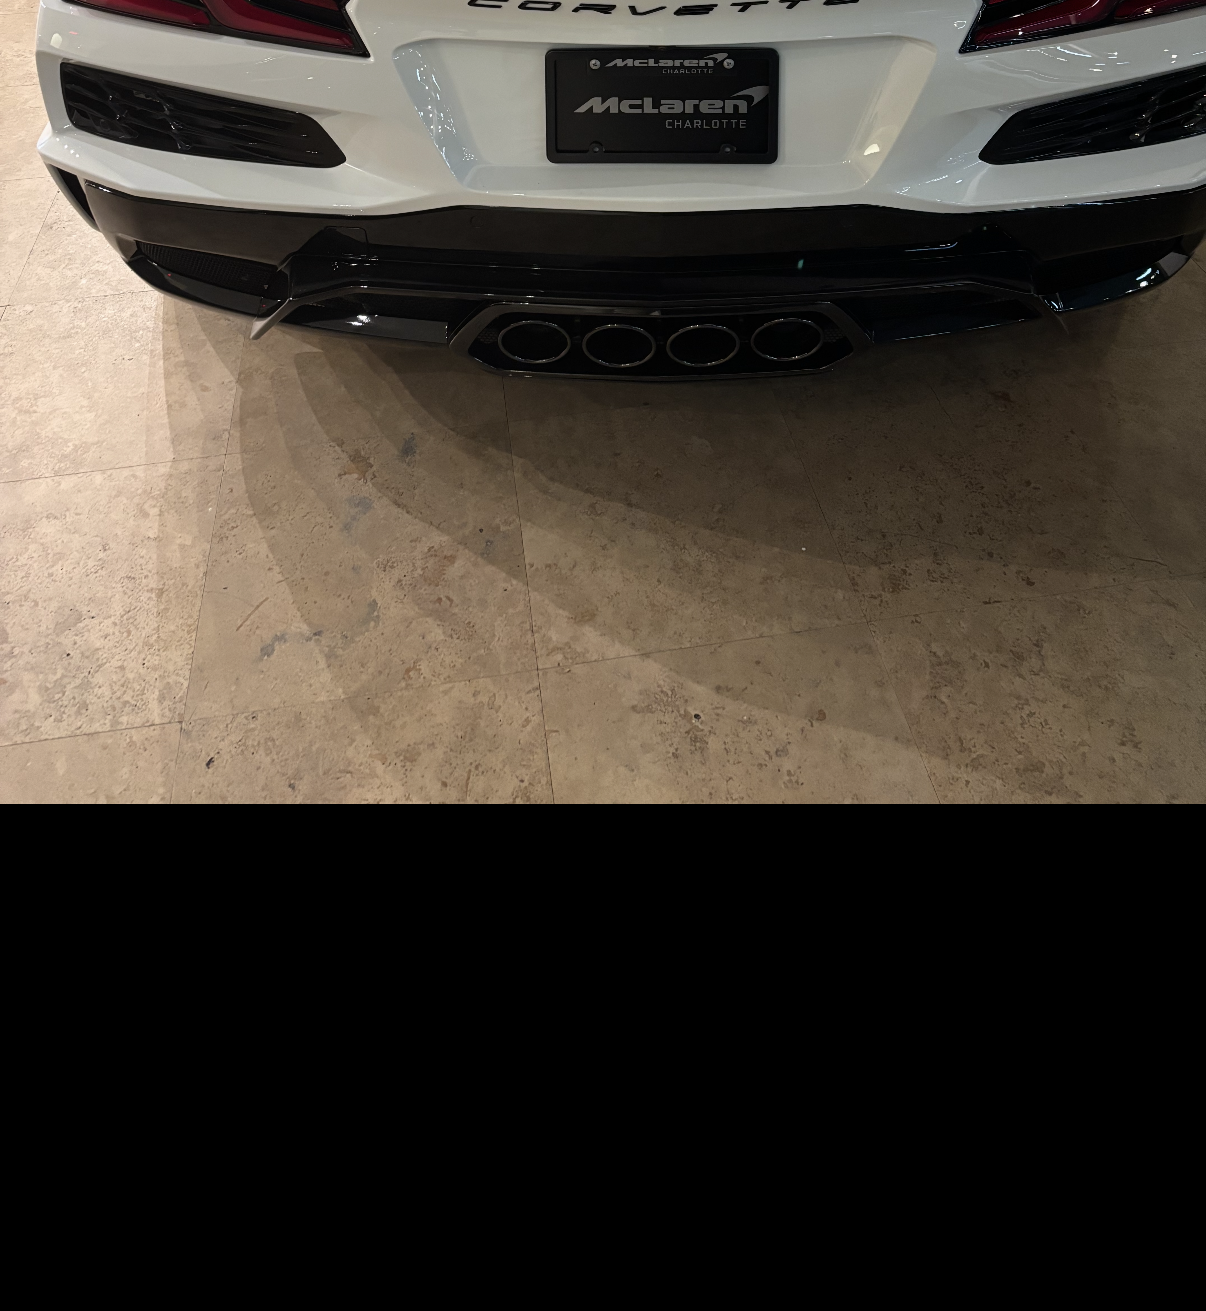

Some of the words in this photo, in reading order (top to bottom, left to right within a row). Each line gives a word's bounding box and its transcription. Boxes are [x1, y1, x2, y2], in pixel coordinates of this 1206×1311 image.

[604, 57, 715, 67] McLaren
[573, 96, 748, 114] McLaren
[665, 119, 747, 129] CHARLOTTE
